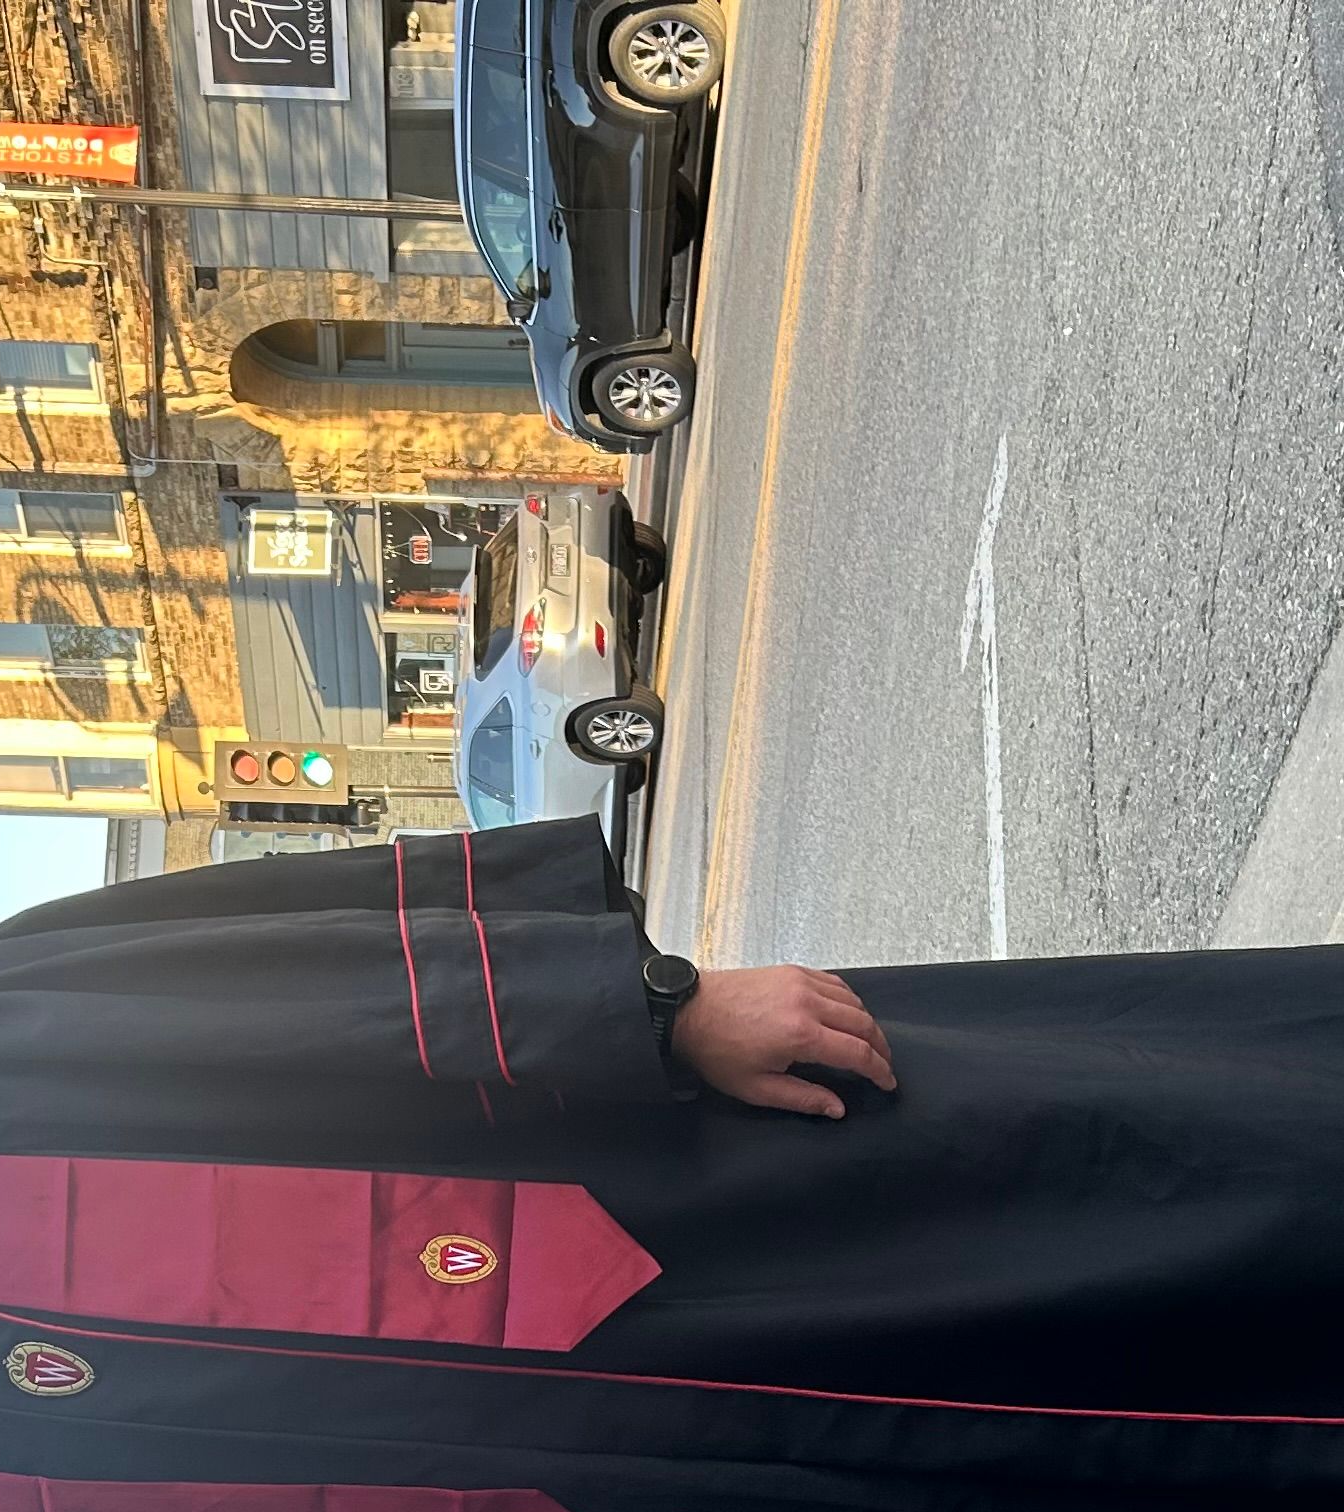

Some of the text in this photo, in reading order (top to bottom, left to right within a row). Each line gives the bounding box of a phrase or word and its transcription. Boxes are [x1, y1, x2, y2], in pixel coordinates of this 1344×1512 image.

[229, 0, 306, 51] St
[306, 0, 327, 65] on sec
[445, 1245, 483, 1273] W
[34, 1354, 77, 1383] W
